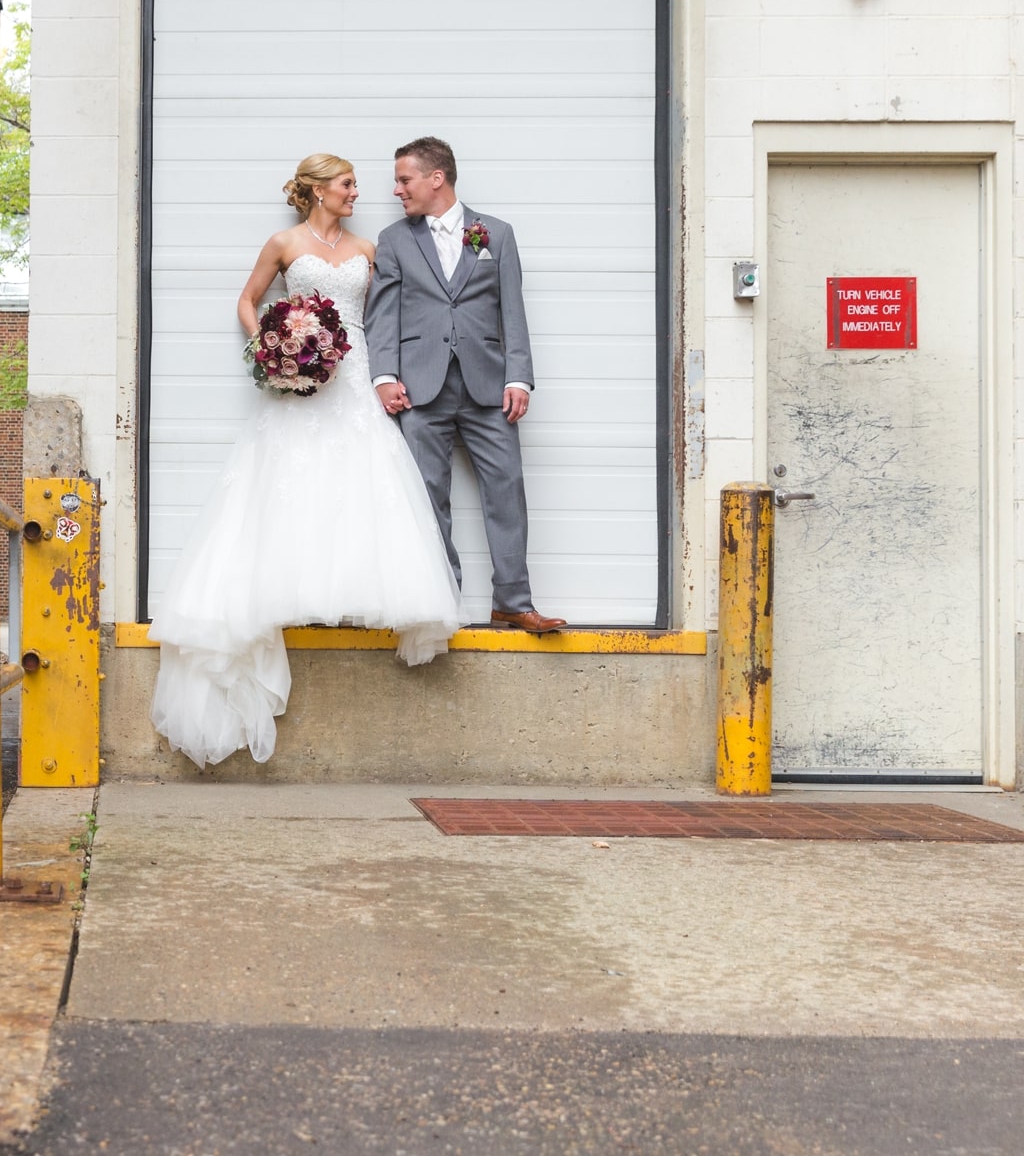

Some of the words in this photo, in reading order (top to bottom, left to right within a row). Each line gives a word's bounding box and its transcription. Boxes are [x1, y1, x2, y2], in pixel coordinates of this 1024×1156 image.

[837, 290, 861, 300] TURN
[865, 290, 901, 300] VEHICLE
[847, 305, 878, 315] ENGINE
[882, 305, 901, 315] OFF
[842, 322, 901, 332] IMMEDIATELY
